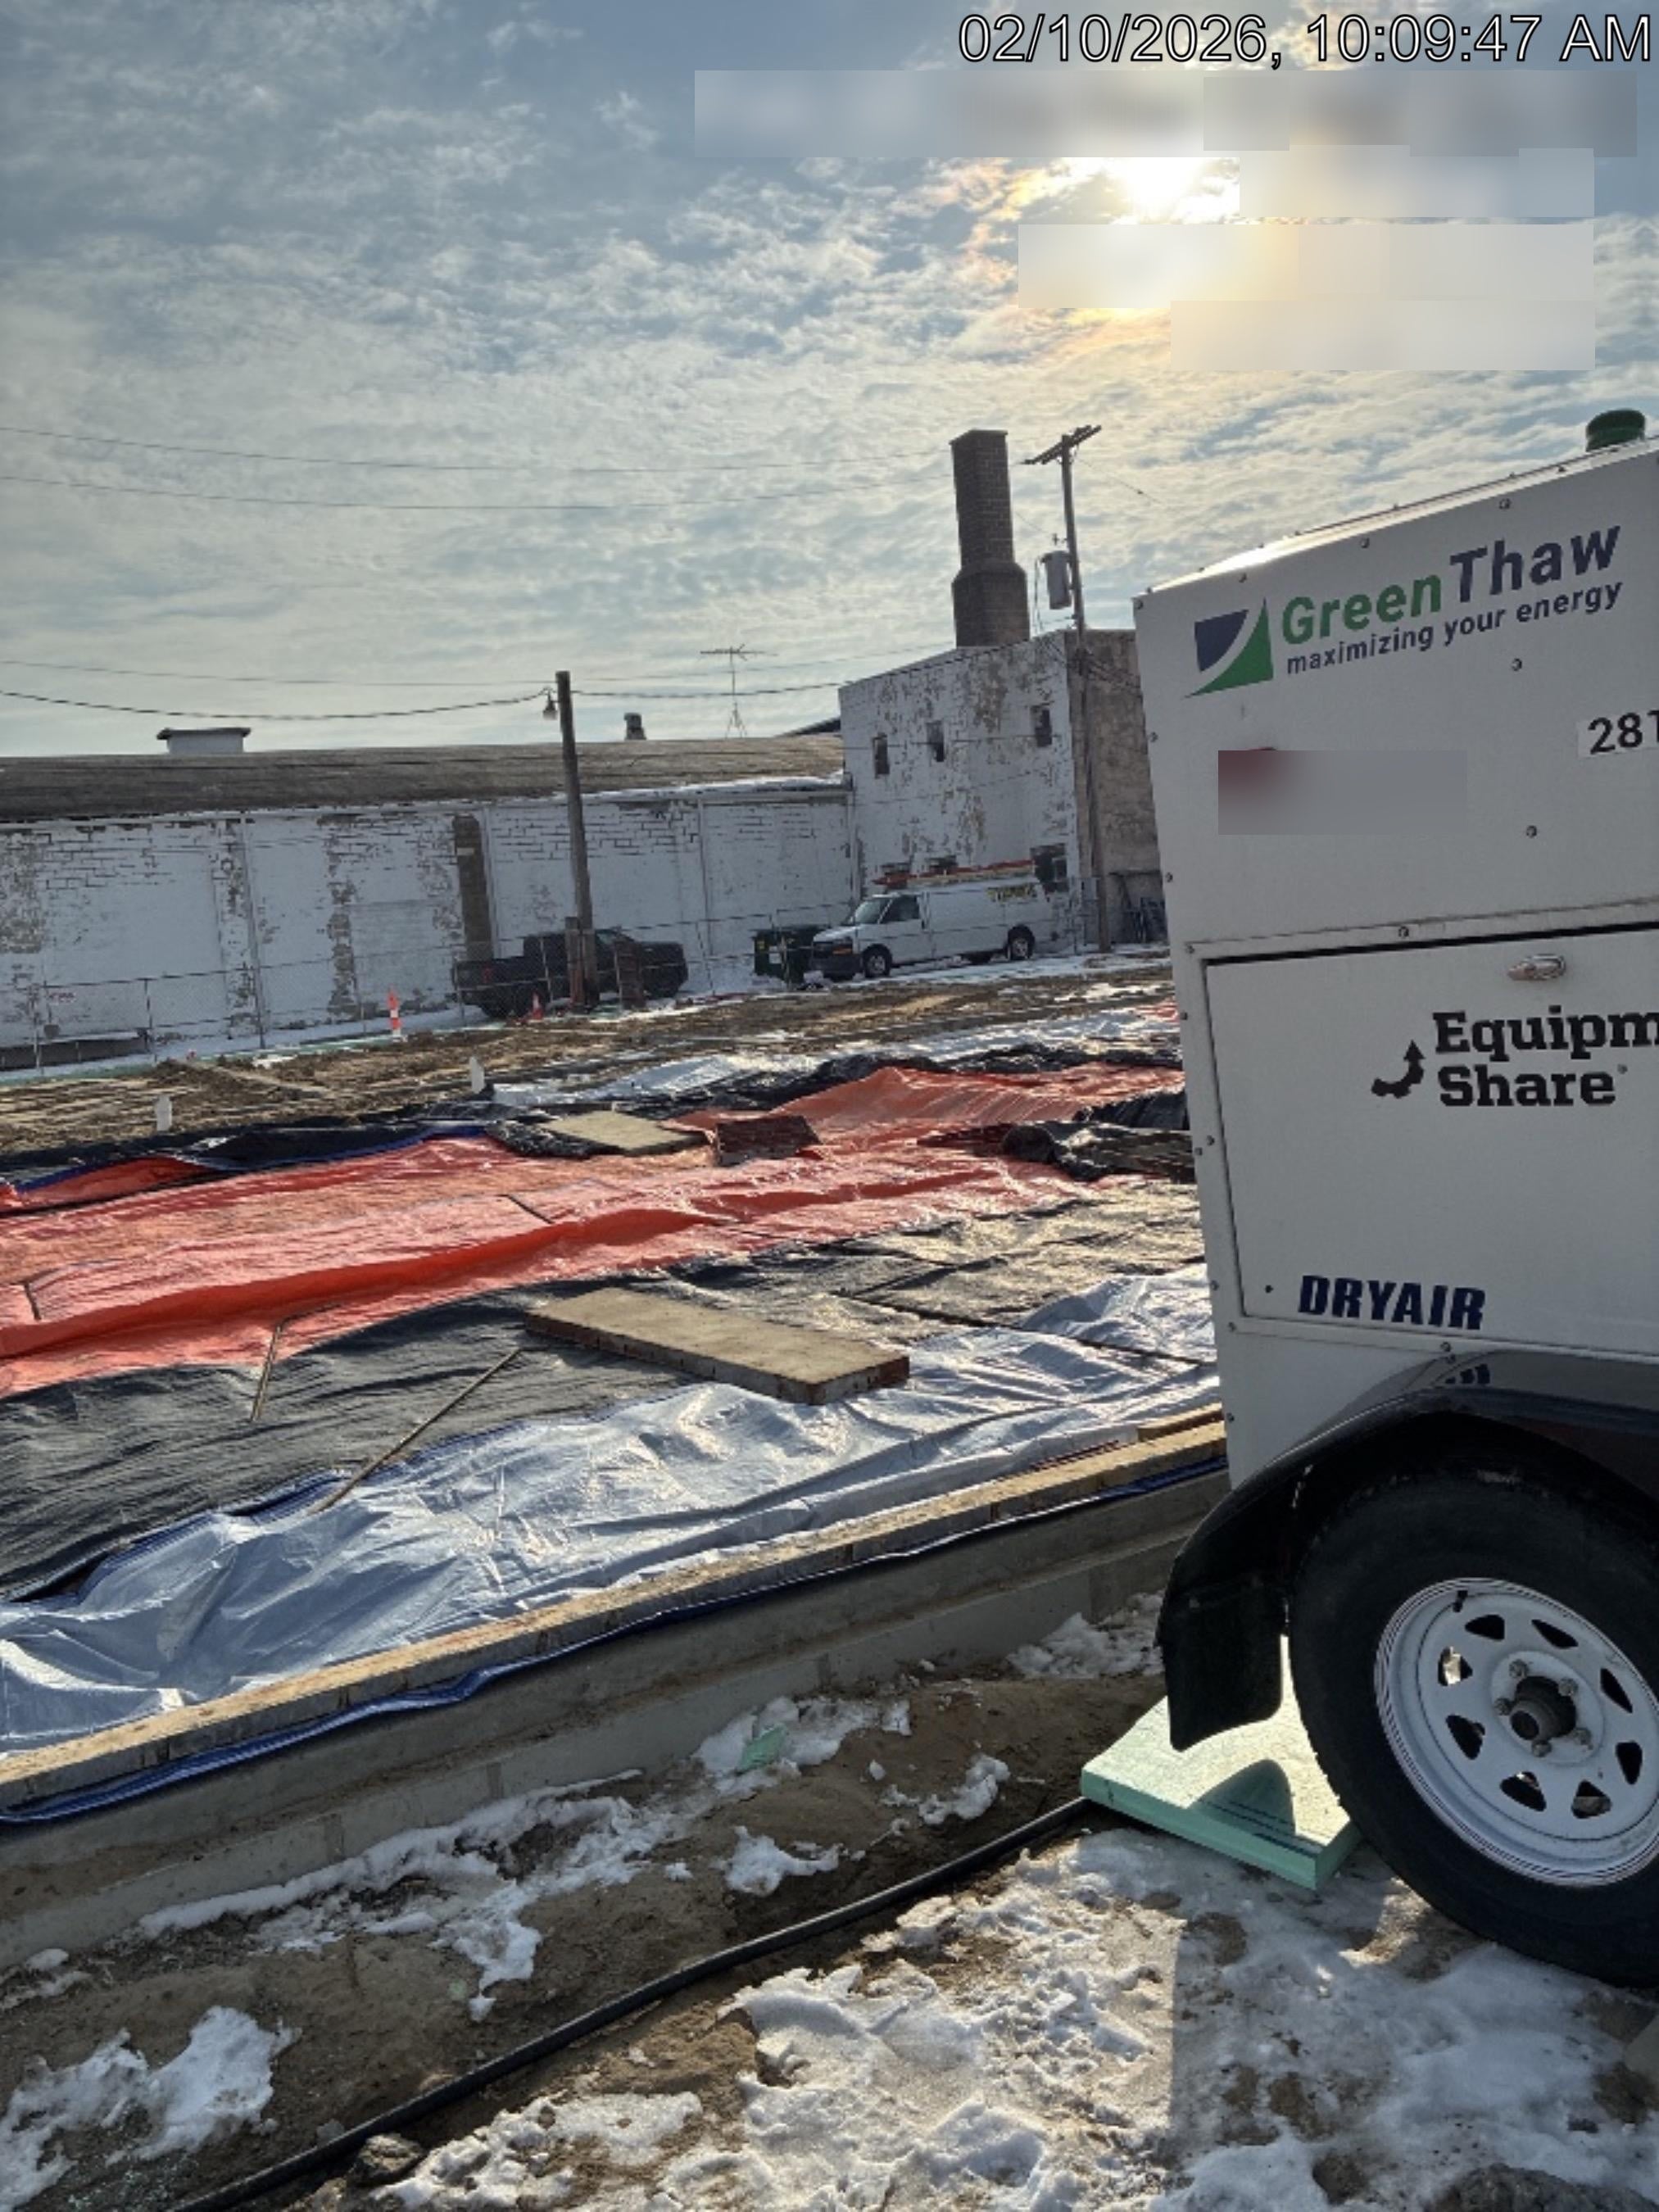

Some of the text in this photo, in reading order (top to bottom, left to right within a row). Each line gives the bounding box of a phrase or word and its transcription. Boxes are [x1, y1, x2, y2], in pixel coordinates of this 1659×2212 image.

[1287, 581, 1624, 675] maximizing your energy
[1437, 1063, 1616, 1107] Share
[1297, 1275, 1486, 1330] DRYAIR
